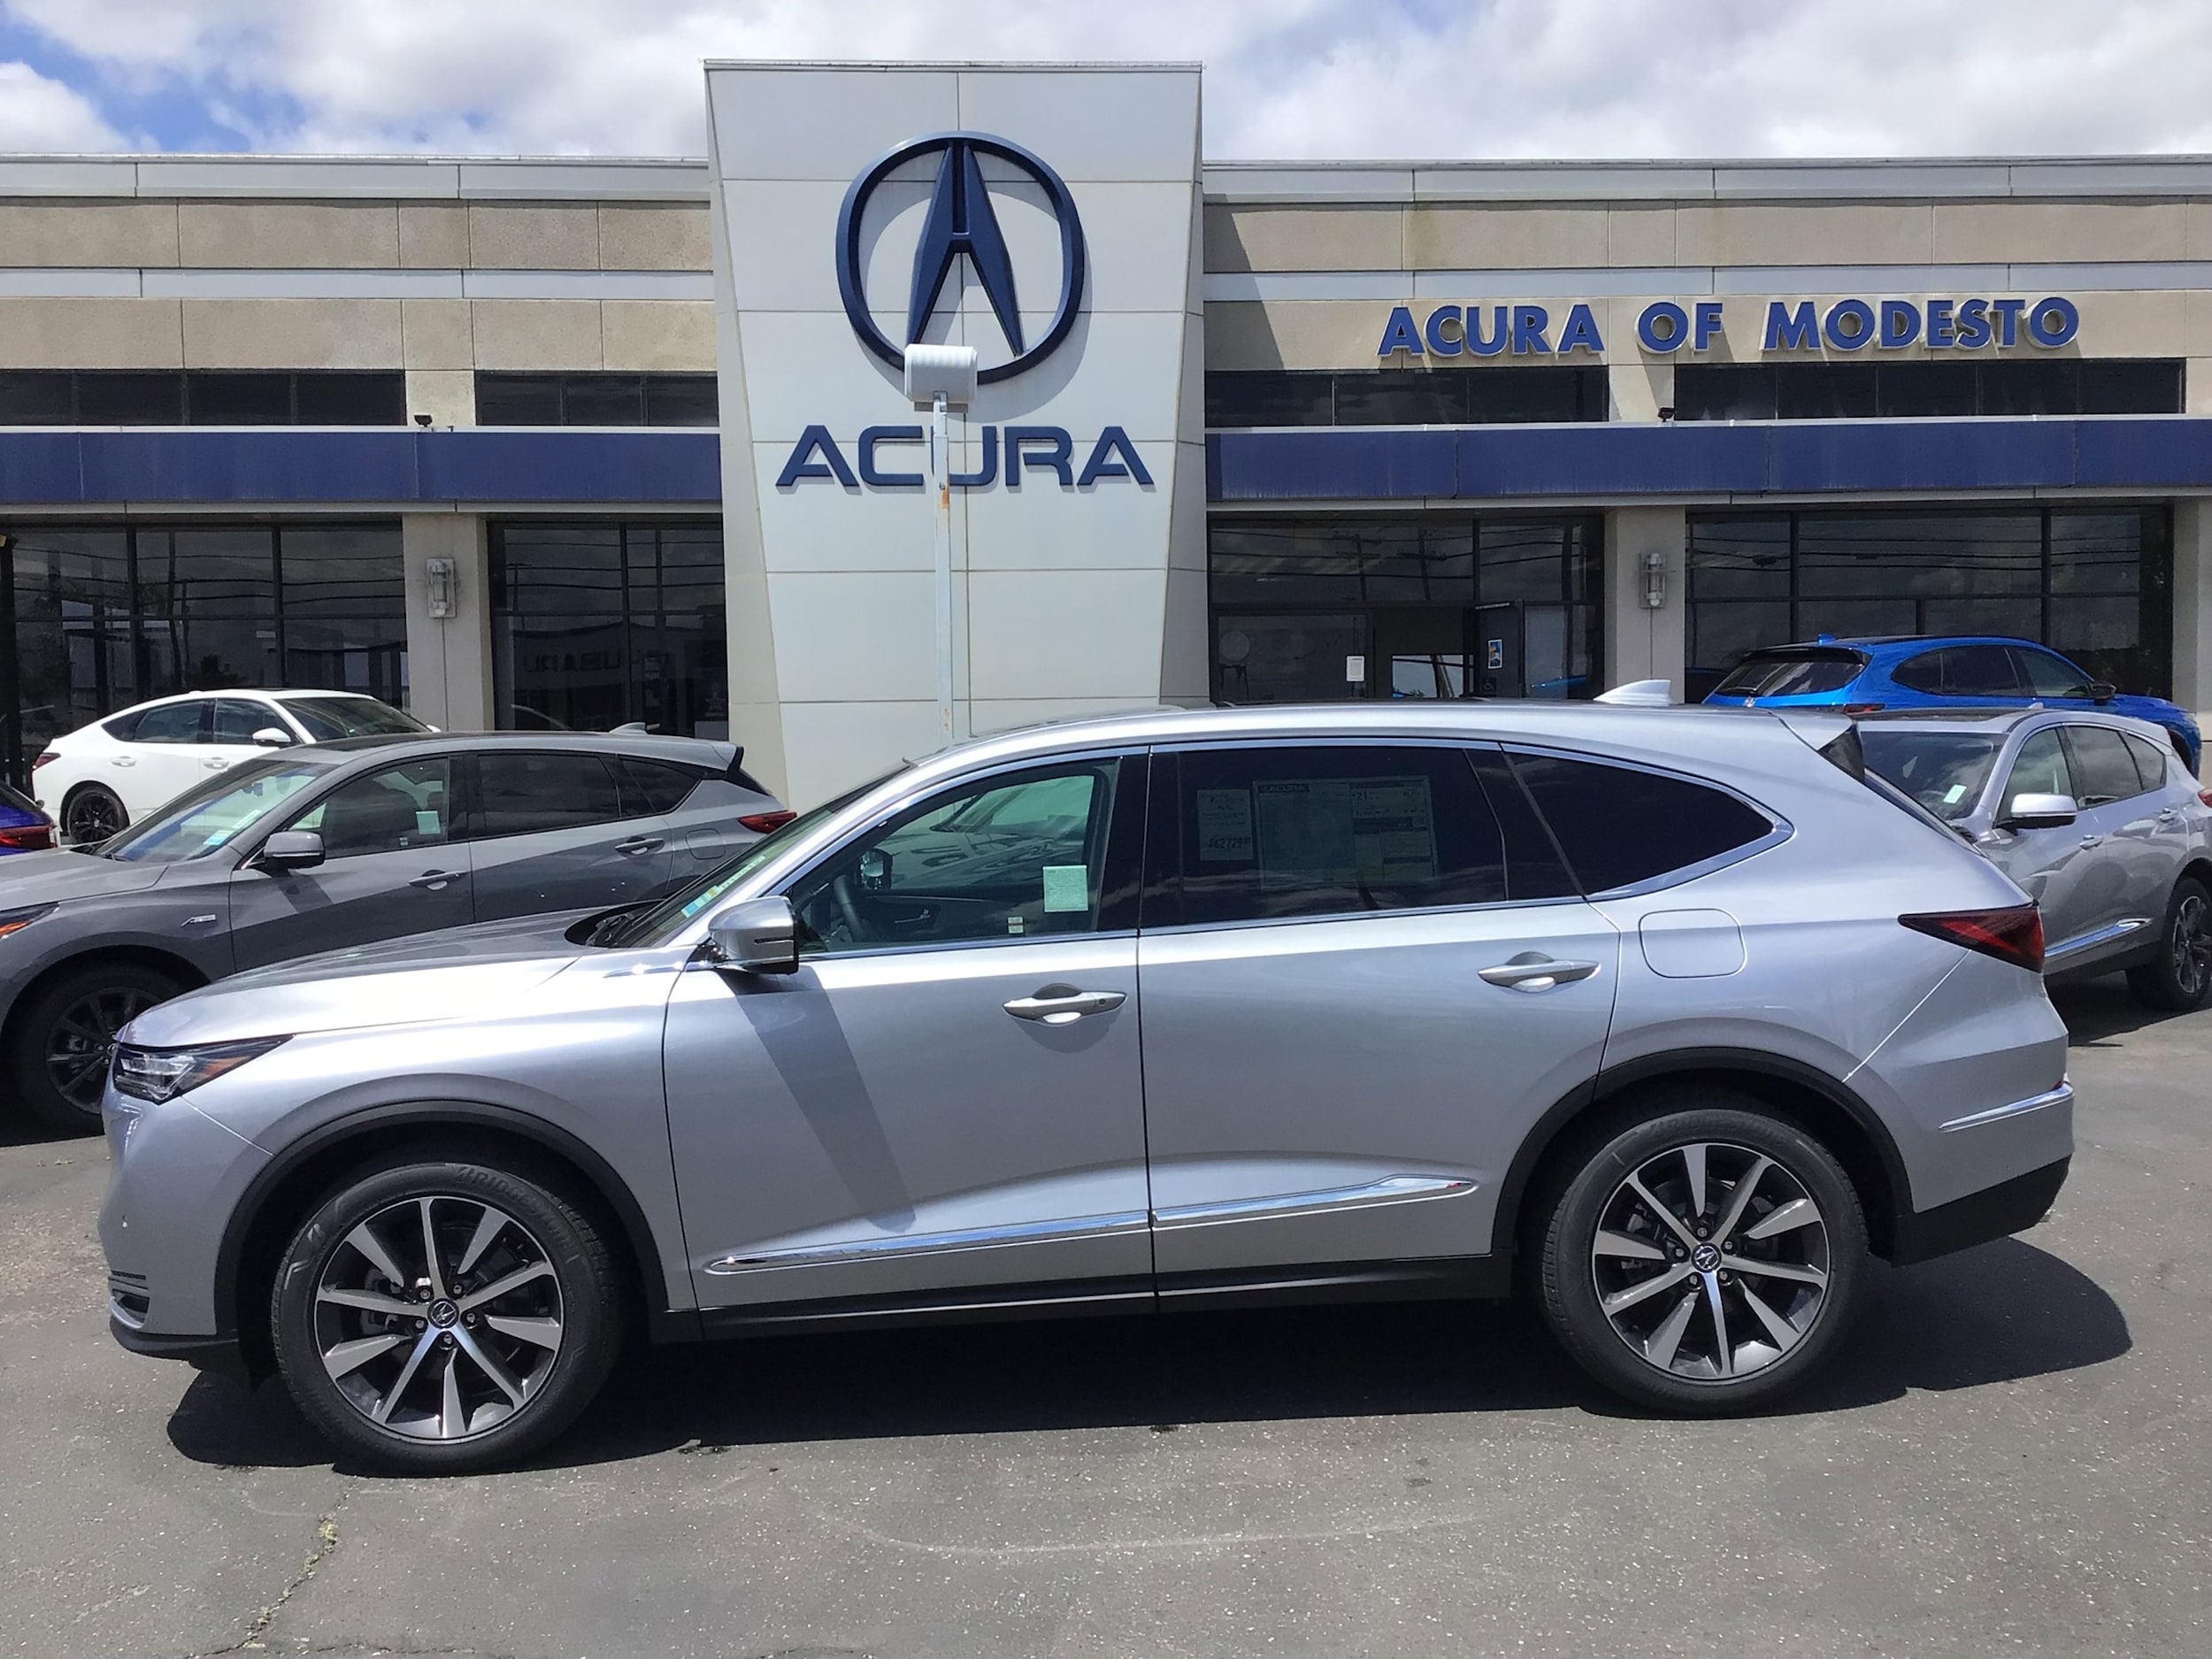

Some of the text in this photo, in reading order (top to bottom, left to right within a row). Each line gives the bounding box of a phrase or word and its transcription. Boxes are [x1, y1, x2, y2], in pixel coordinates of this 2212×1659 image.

[1379, 296, 2080, 356] ACURA OF MODESTO
[775, 425, 1155, 488] ACURA
